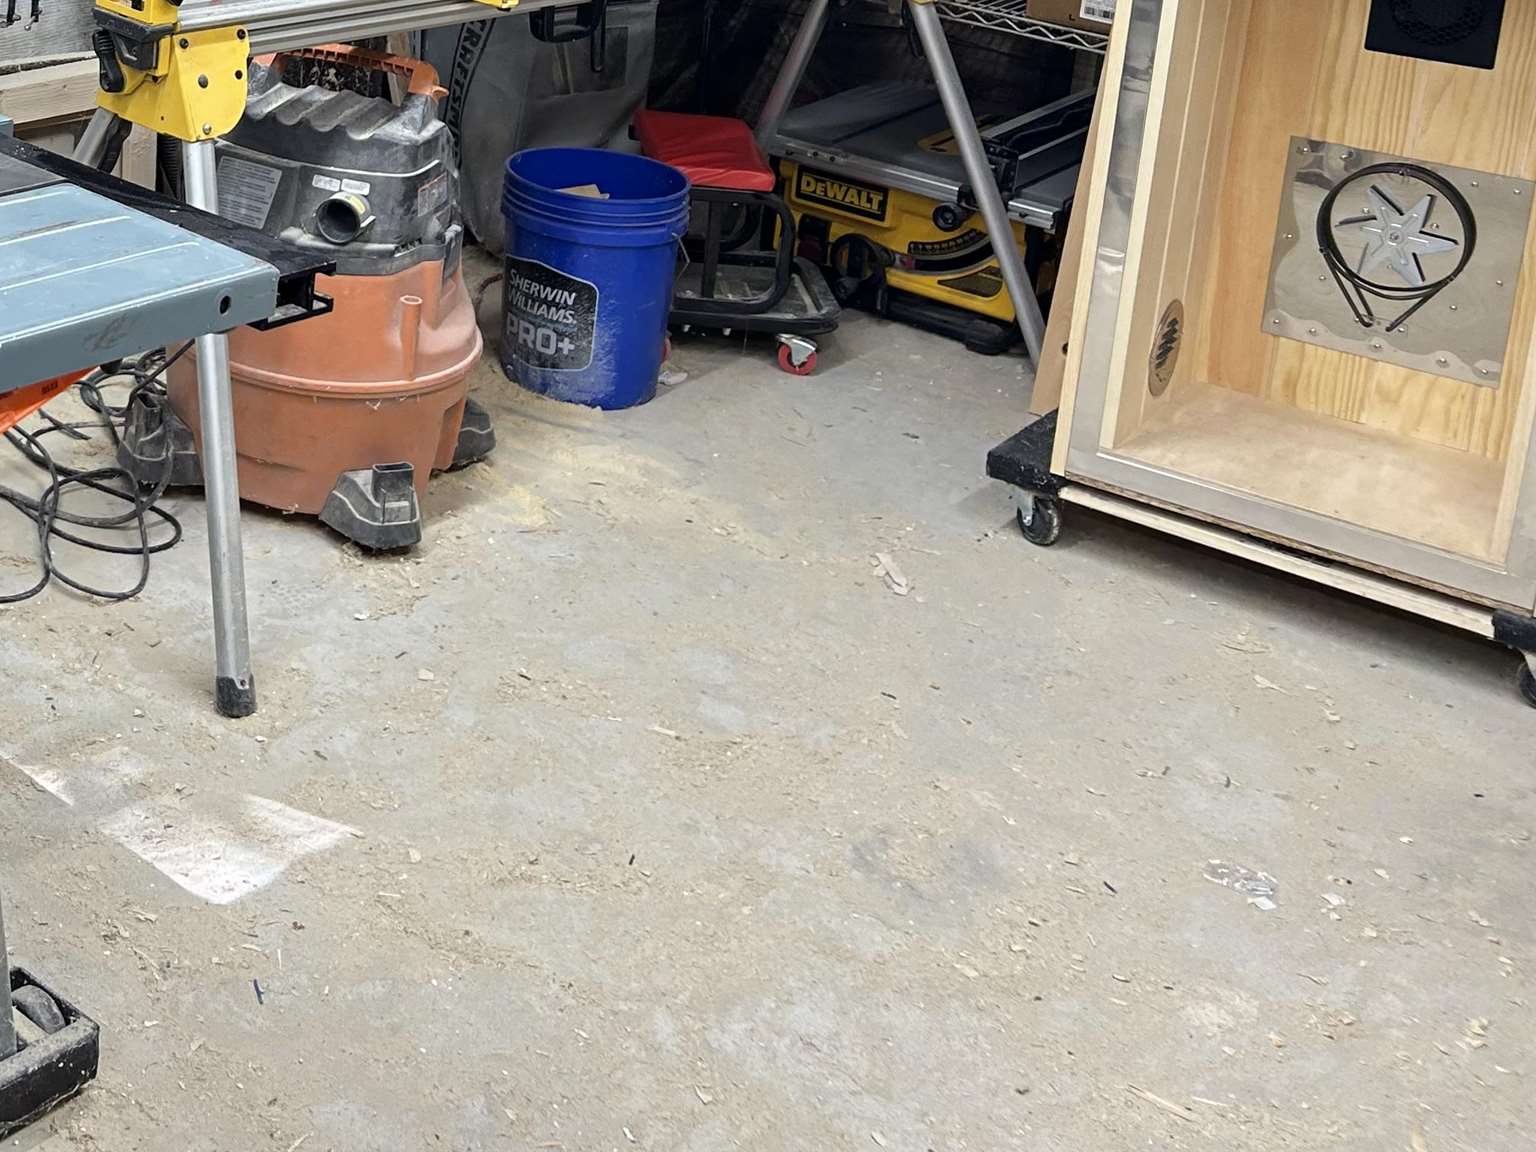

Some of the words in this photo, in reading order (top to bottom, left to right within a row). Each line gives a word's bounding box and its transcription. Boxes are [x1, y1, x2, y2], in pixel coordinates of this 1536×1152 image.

[800, 174, 883, 211] DEWALT
[509, 268, 576, 306] SHERWIN
[506, 311, 576, 355] PRO+
